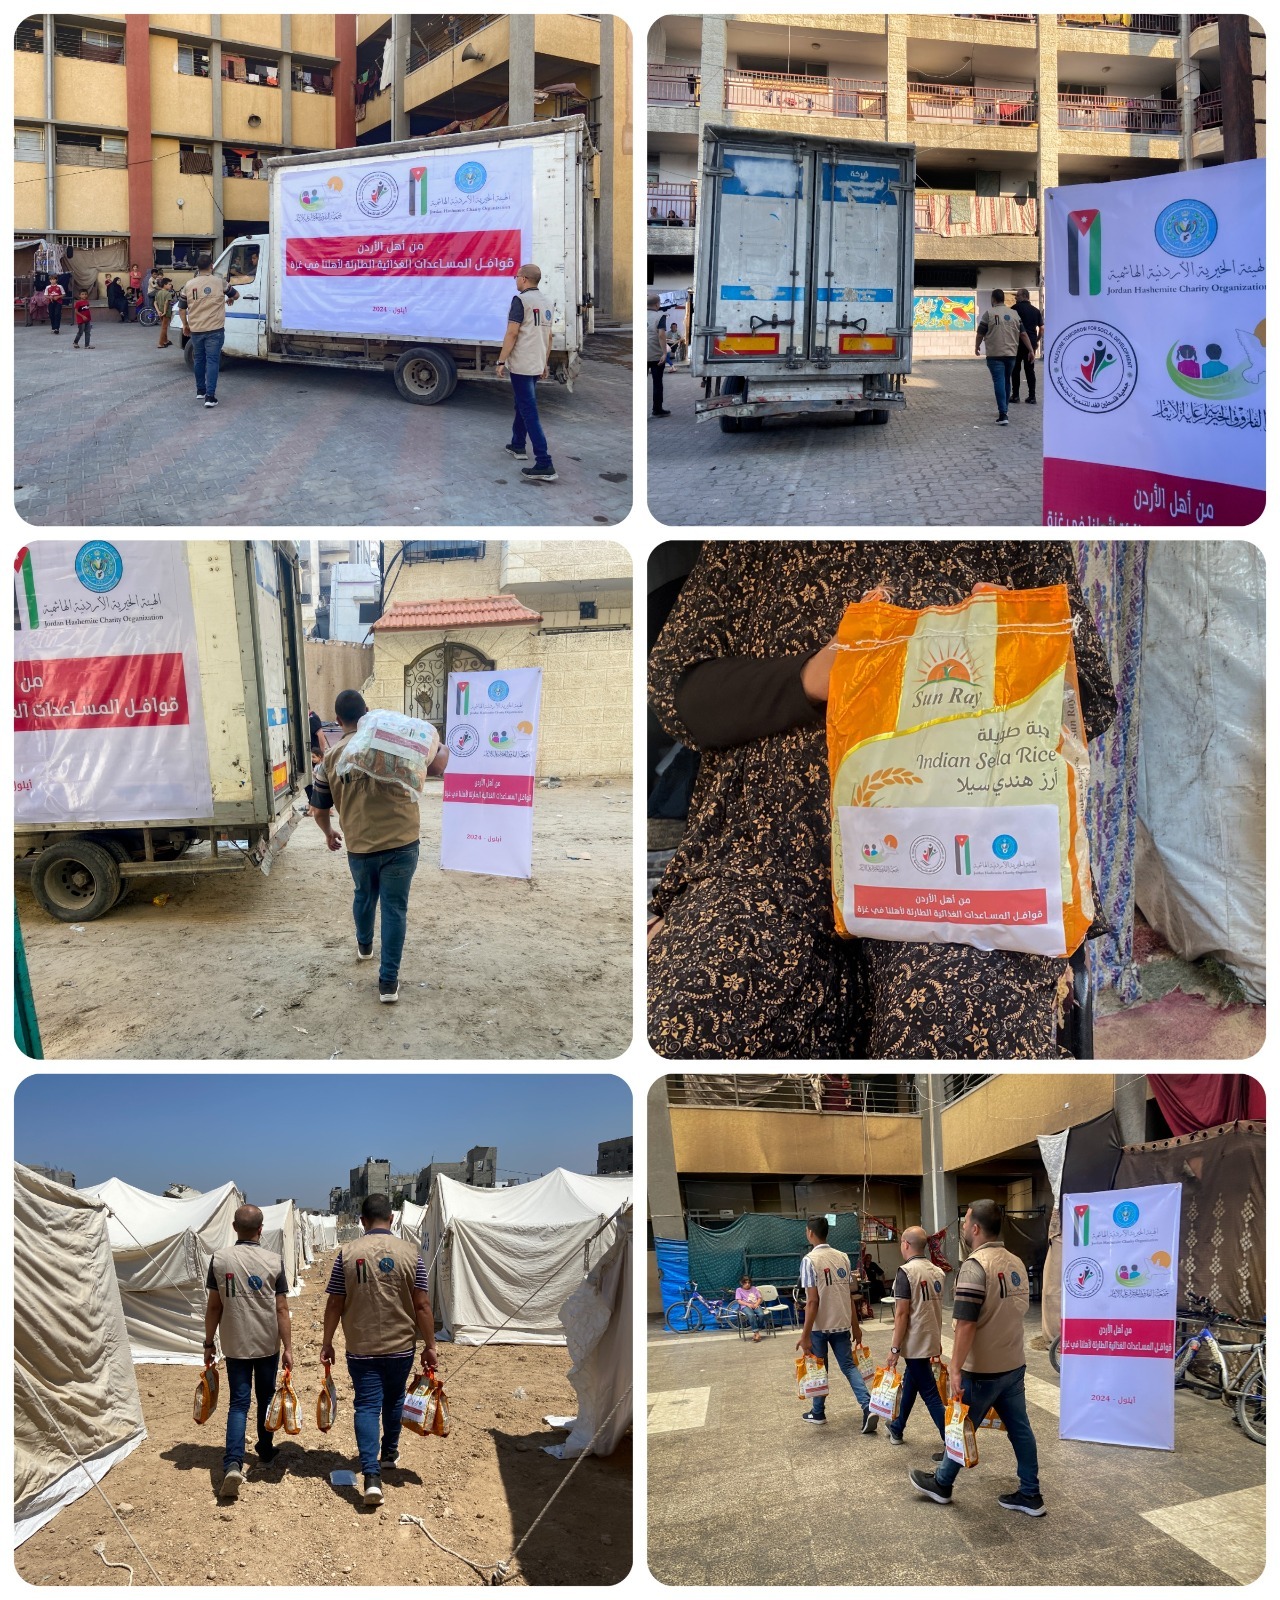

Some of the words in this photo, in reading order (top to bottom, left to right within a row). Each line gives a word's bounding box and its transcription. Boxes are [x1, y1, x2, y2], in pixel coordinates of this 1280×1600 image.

[850, 170, 869, 179] شركة
[357, 241, 383, 254] الأردن
[386, 240, 405, 254] أهل
[409, 243, 424, 253] من
[290, 260, 302, 271] غزة
[304, 260, 320, 271] في
[322, 259, 343, 269] لأهلنا
[345, 259, 375, 271] الطارئة
[377, 259, 412, 271] الغذائية
[414, 258, 472, 269] المساعدات
[474, 257, 515, 271] قوافل
[1107, 264, 1145, 283] الهاشمية
[1147, 260, 1195, 282] الأردنية
[1196, 259, 1236, 281] الخيرية
[1107, 286, 1132, 295] Jordan
[1134, 286, 1177, 294] Hashemite
[1179, 284, 1209, 294] Charity
[393, 306, 408, 315] أيلول
[1054, 342, 1065, 363] PALESTINE
[1063, 326, 1088, 342] TOMORROW
[1097, 326, 1114, 339] SOCIAL
[1113, 335, 1133, 369] DEVELOPMENT
[1134, 483, 1165, 512] الأردن
[1170, 490, 1192, 518] أهل
[1196, 502, 1214, 524] من
[74, 596, 110, 614] الأردنية
[112, 594, 138, 612] الخيرية
[140, 592, 161, 609] الهيئة
[43, 598, 72, 616] الهاشمية
[44, 619, 64, 628] Jordan
[65, 618, 98, 626] Hashemite
[100, 616, 122, 625] Charity
[123, 613, 164, 623] Organization
[20, 676, 43, 693] من
[912, 691, 943, 708] Sun
[948, 687, 982, 709] Ray
[33, 698, 120, 718] المساعدات
[124, 697, 179, 718] قوافل
[1067, 698, 1076, 718] Ray
[916, 752, 970, 770] Indian
[976, 752, 1011, 770] Sela
[1015, 746, 1057, 764] Rice
[1039, 767, 1058, 791] أرز
[957, 776, 990, 796] سيلا
[993, 775, 1033, 796] هندي
[915, 893, 937, 904] الأردن
[939, 894, 956, 906] أهل
[958, 897, 971, 906] من
[857, 905, 869, 914] غزة
[870, 907, 885, 915] في
[885, 905, 905, 915] لأهلنا
[906, 908, 932, 918] الطارئة
[933, 909, 962, 918] الغذائية
[964, 910, 1010, 920] المساعدات
[1012, 910, 1043, 921] قوافل
[1098, 1323, 1113, 1336] الأردن
[1113, 1324, 1123, 1336] أهل
[1124, 1328, 1132, 1336] من
[1126, 1342, 1154, 1351] المساعدات
[1154, 1343, 1172, 1353] قوافل
[1117, 1397, 1136, 1405] أيلول
